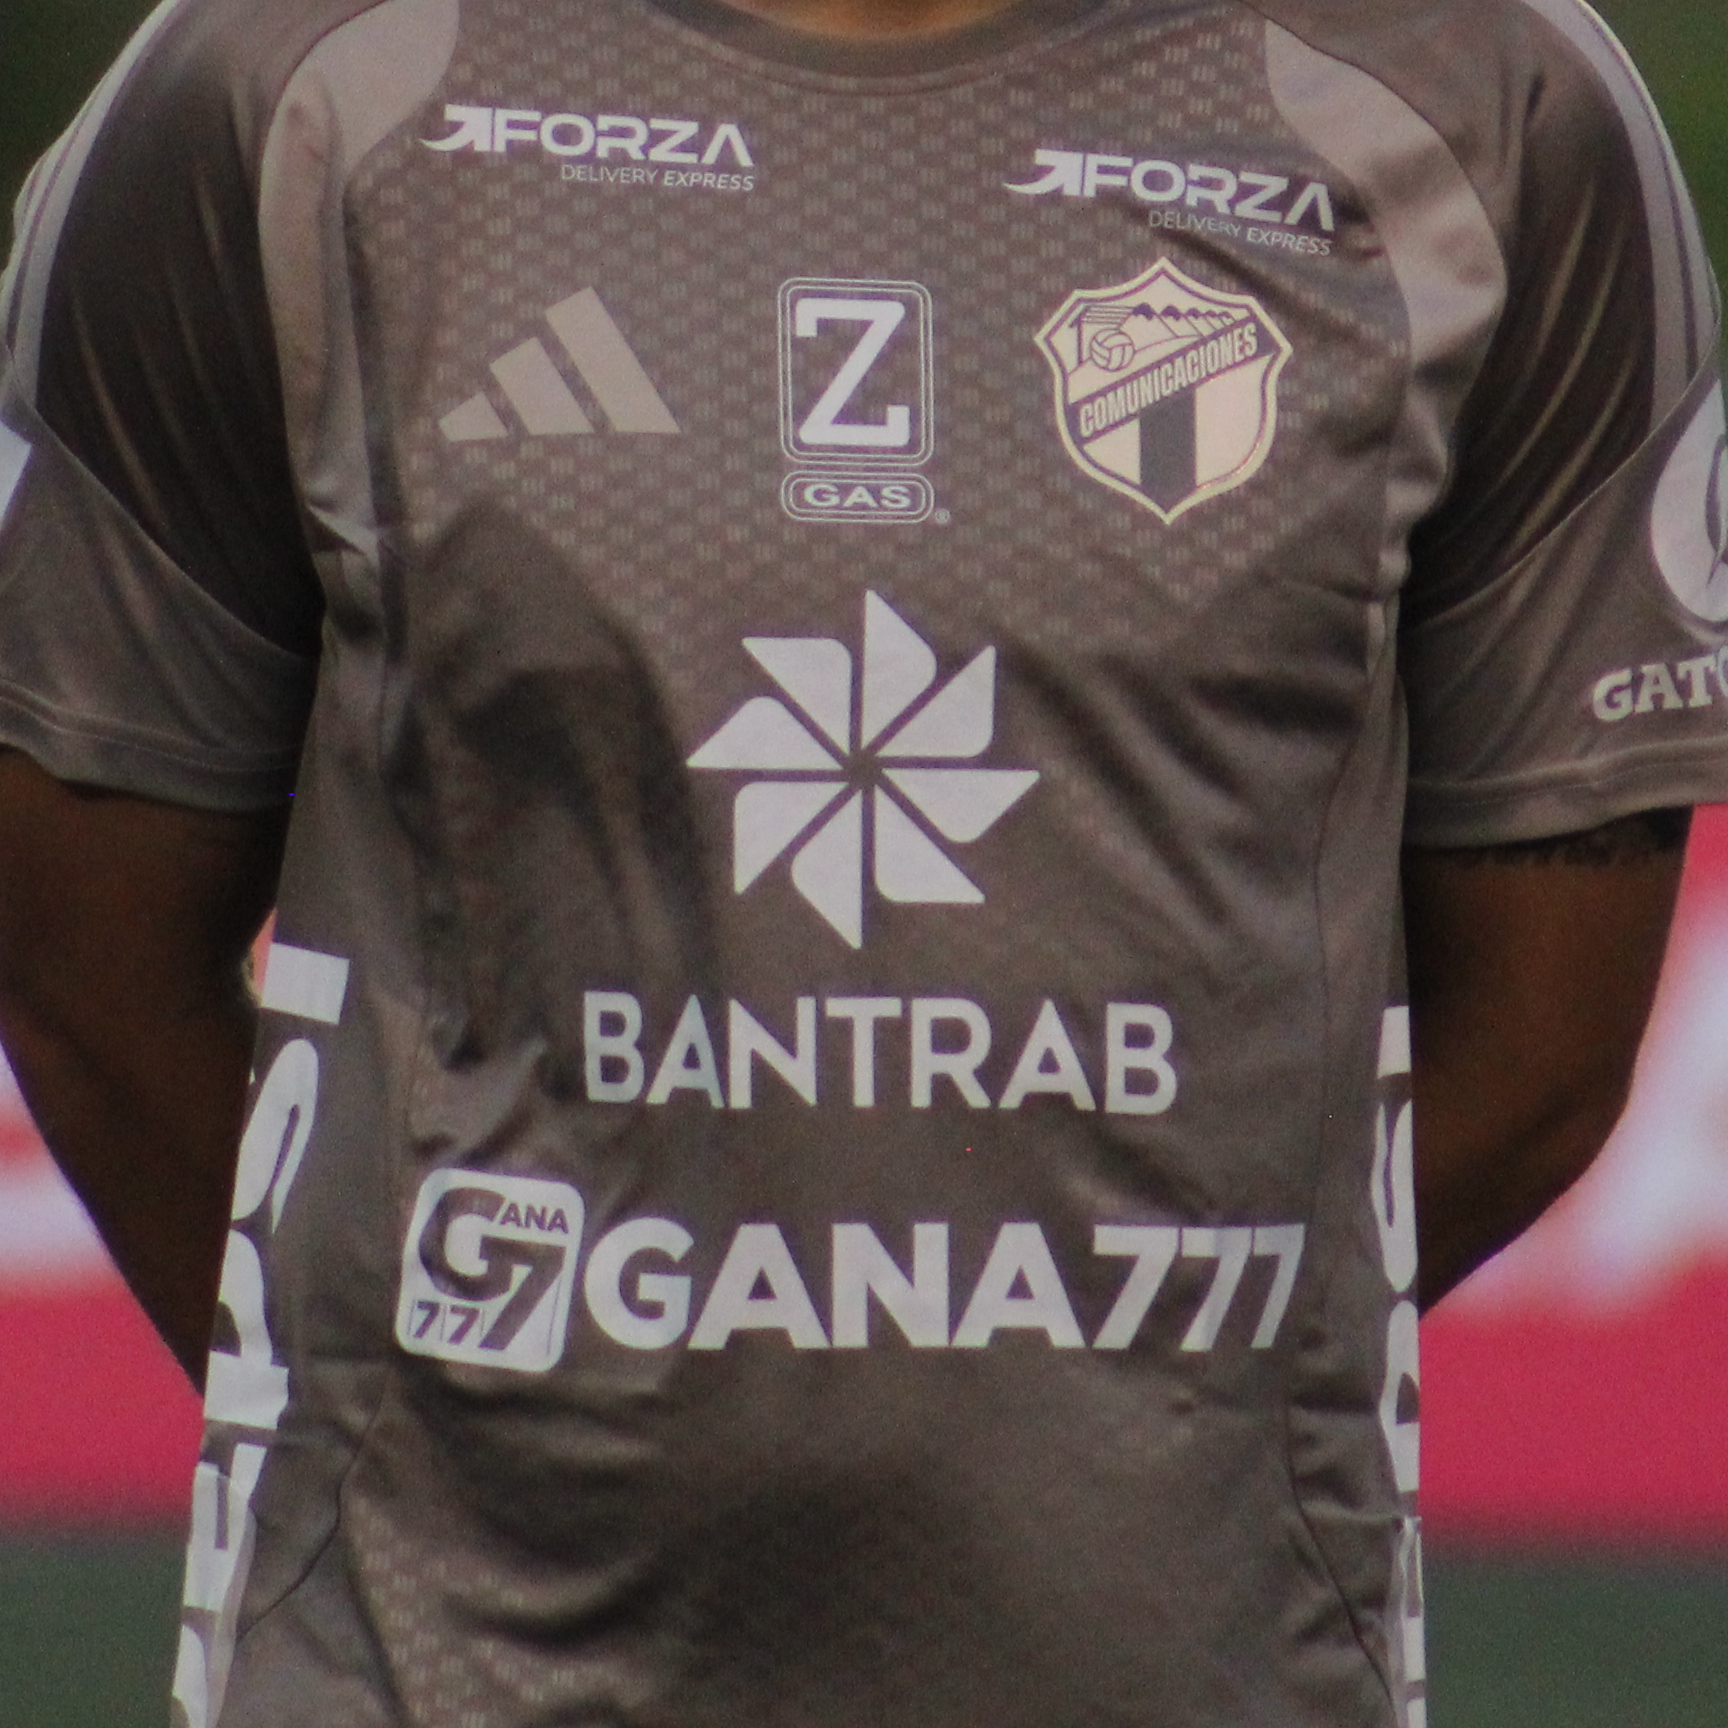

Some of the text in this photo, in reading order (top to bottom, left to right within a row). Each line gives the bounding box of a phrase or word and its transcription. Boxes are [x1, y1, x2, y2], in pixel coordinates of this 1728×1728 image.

[492, 107, 755, 168] FORZA
[561, 164, 755, 192] DELIVERY EXPRESS
[1083, 151, 1336, 232] FORZA
[1149, 209, 1333, 256] DELIVERY EXPRESS
[795, 298, 911, 447] Z
[1079, 322, 1258, 439] COMUNICACIONES
[803, 483, 912, 509] GAS
[582, 990, 1178, 1116] BANTRAB
[584, 1217, 1306, 1353] GANA777
